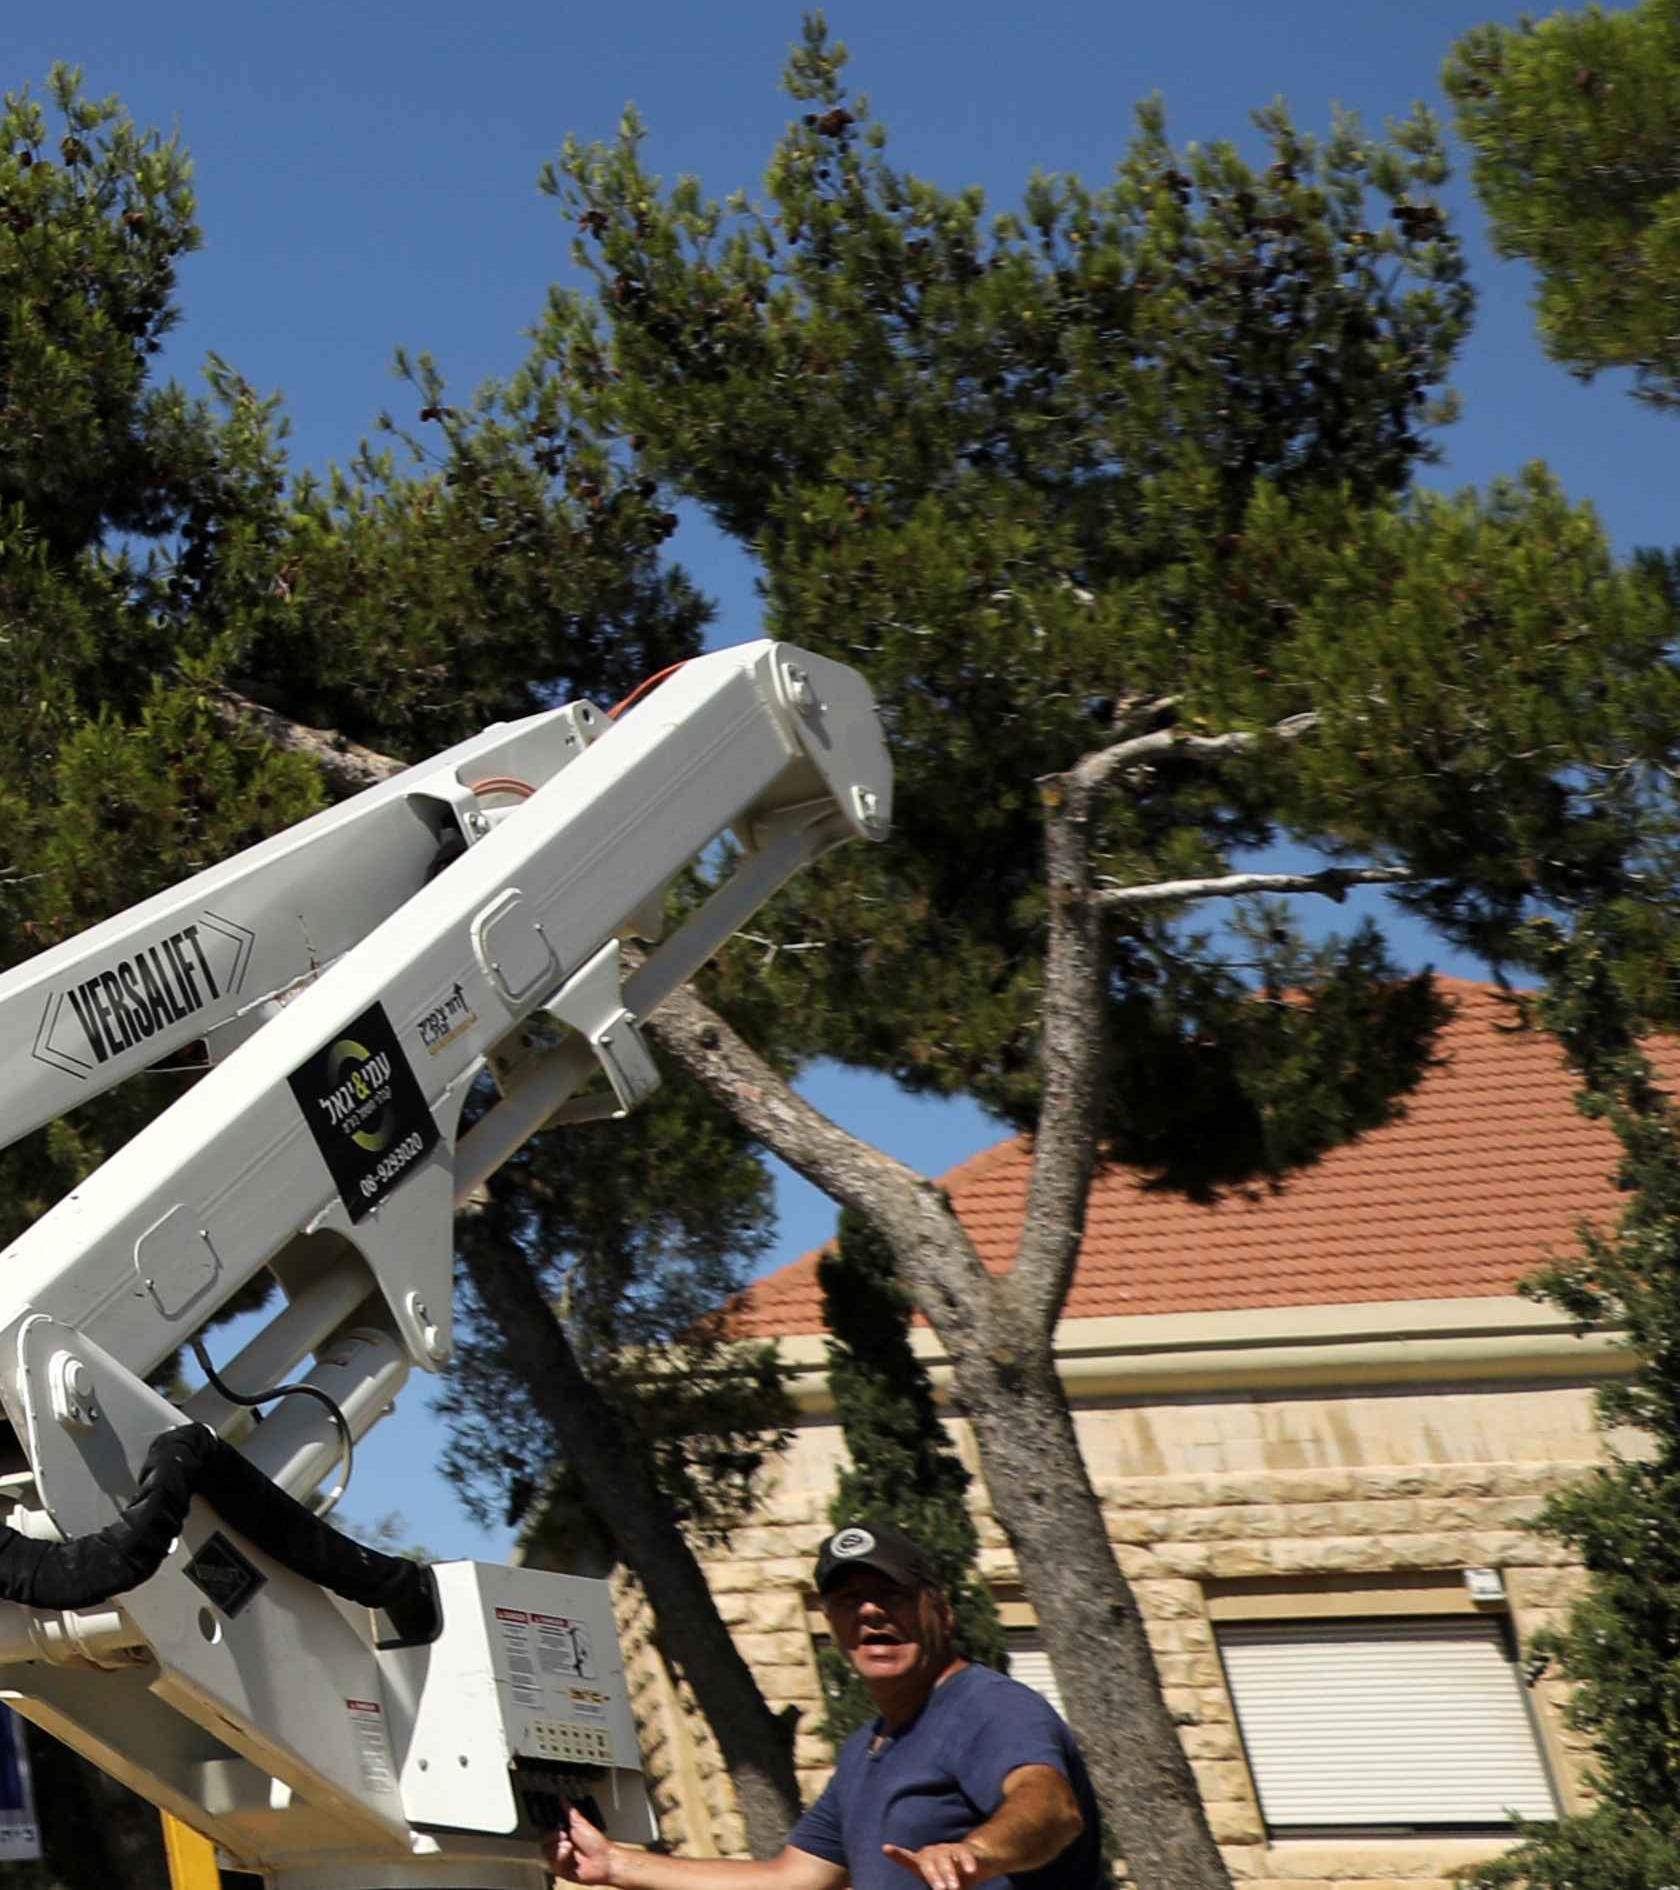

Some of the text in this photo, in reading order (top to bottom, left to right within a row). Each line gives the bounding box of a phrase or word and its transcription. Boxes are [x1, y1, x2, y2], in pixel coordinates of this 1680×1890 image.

[67, 925, 220, 1063] VERSALIFT
[319, 1051, 392, 1125] עמי&יגאל
[360, 1131, 423, 1197] 08-9293020
